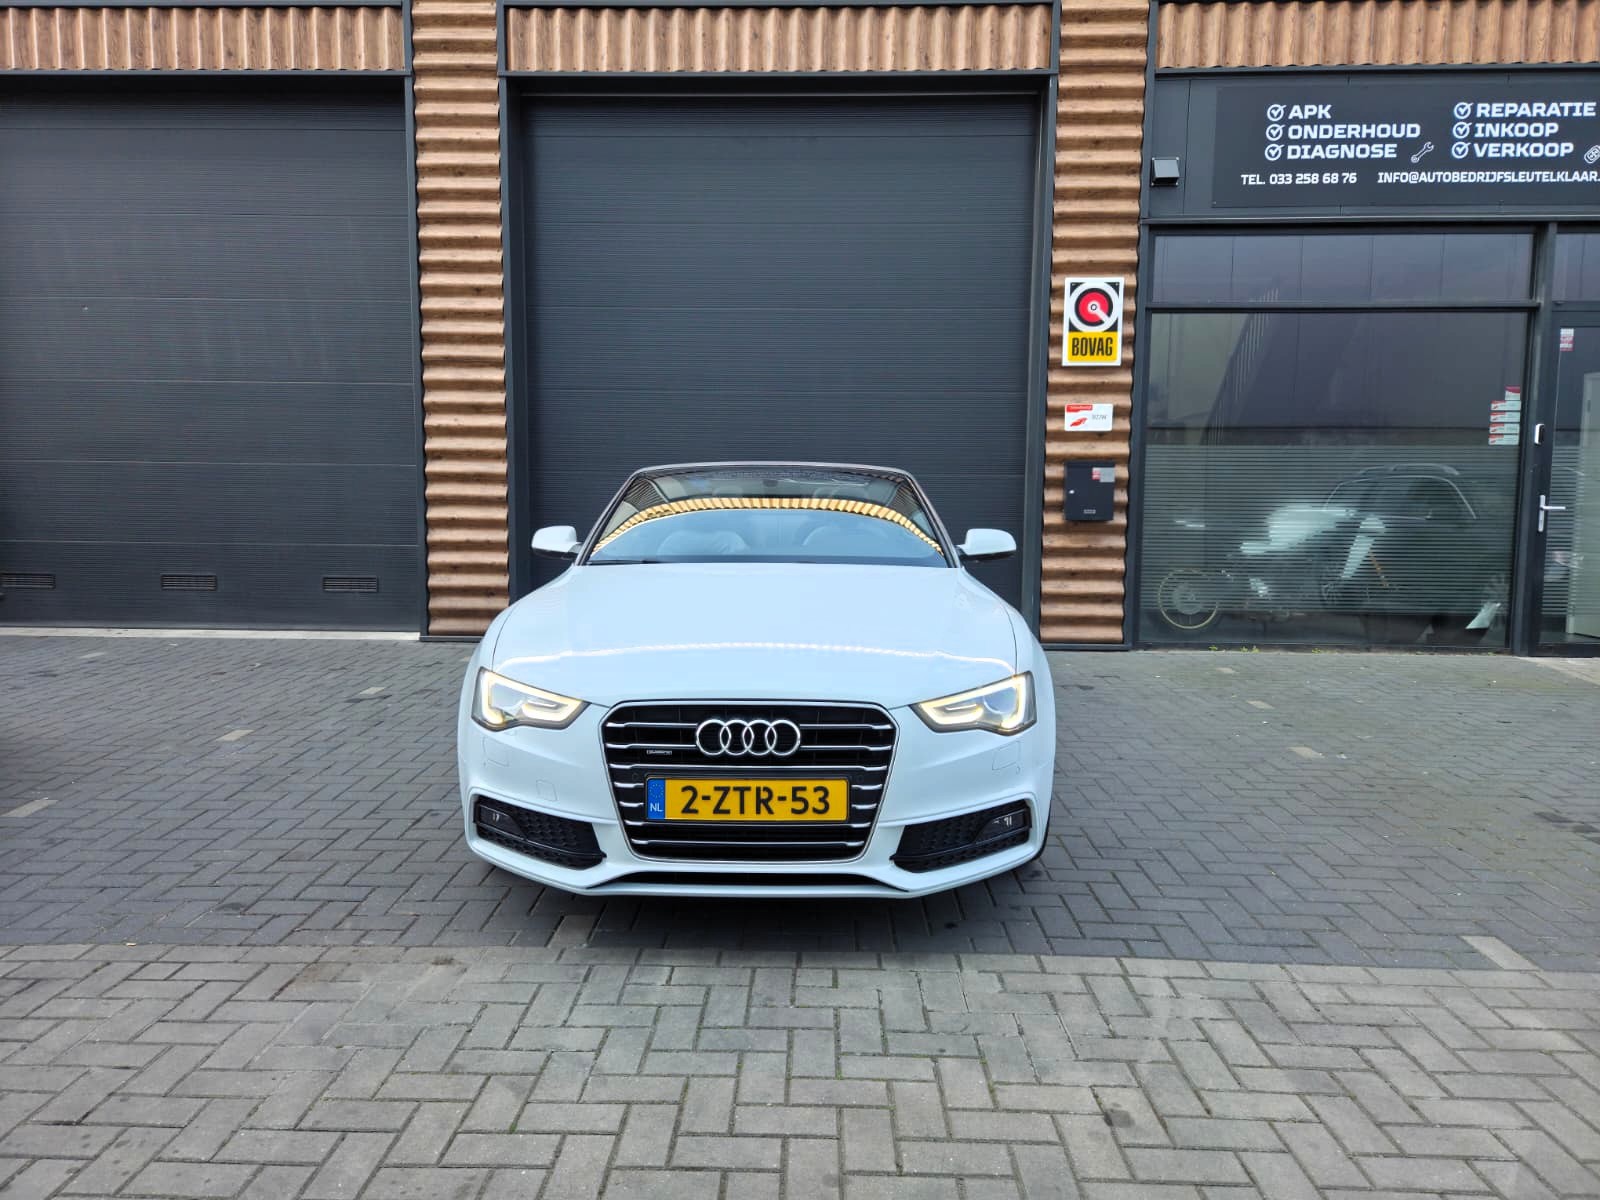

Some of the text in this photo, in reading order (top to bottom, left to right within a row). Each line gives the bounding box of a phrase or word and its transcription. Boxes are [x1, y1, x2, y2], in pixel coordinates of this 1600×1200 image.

[1288, 104, 1332, 120] APK
[1476, 102, 1596, 118] REPARATIE
[1288, 123, 1421, 139] ONDERHOUD
[1474, 122, 1559, 138] INKOOP
[1287, 143, 1398, 159] DIAGNOSE
[1474, 142, 1574, 158] VERKOOP
[1241, 172, 1357, 185] TEL. 033 258 68 76
[1072, 337, 1113, 356] BOVAG
[650, 786, 830, 815] NL 2-ZTR-53
